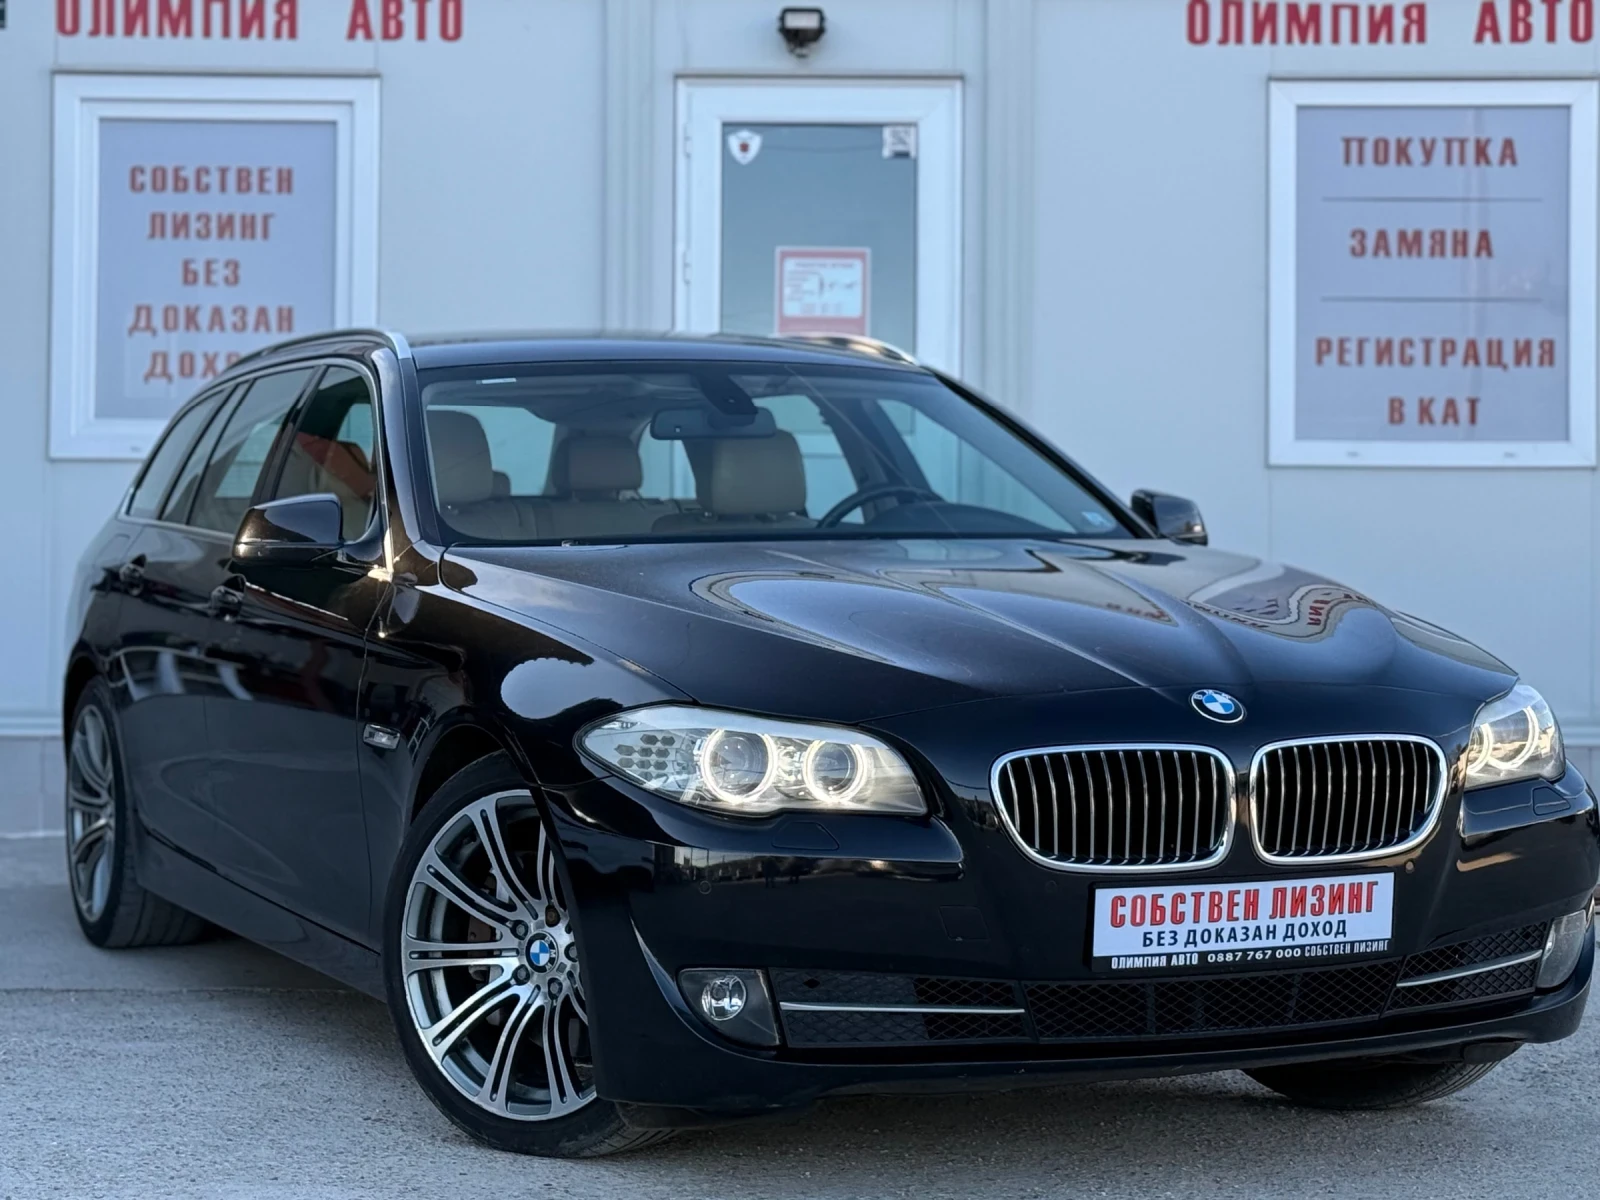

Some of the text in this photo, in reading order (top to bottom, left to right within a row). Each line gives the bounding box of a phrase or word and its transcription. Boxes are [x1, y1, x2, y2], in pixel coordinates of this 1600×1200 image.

[56, 0, 464, 42] ОЛИМПИЯ АВТО
[1186, 0, 1594, 45] ОЛИМПИЯ АВТО
[1341, 137, 1518, 166] ПОКУПКА
[129, 165, 294, 195] СОБСТВЕН
[147, 211, 276, 241] ЛИЗИНГ
[1349, 228, 1495, 258] ЗАМЯНА
[181, 258, 241, 287] БЕЗ
[128, 304, 295, 338] ДОКАЗАН
[1315, 337, 1556, 372] РЕГИСТРАЦИЯ
[1388, 396, 1482, 426] В КАТ
[1110, 880, 1379, 928] СОБСТВЕН ЛИЗИНГ
[1142, 919, 1348, 948] БЕЗ ДОКАЗАН ДОХОД
[1111, 955, 1167, 970] ОЛИМПИЯ
[1171, 953, 1199, 967] АВТО
[1207, 951, 1242, 963] 0887
[1246, 949, 1272, 961] 767
[1275, 947, 1302, 959] 000
[1354, 940, 1389, 954] ЛИЗИНГ
